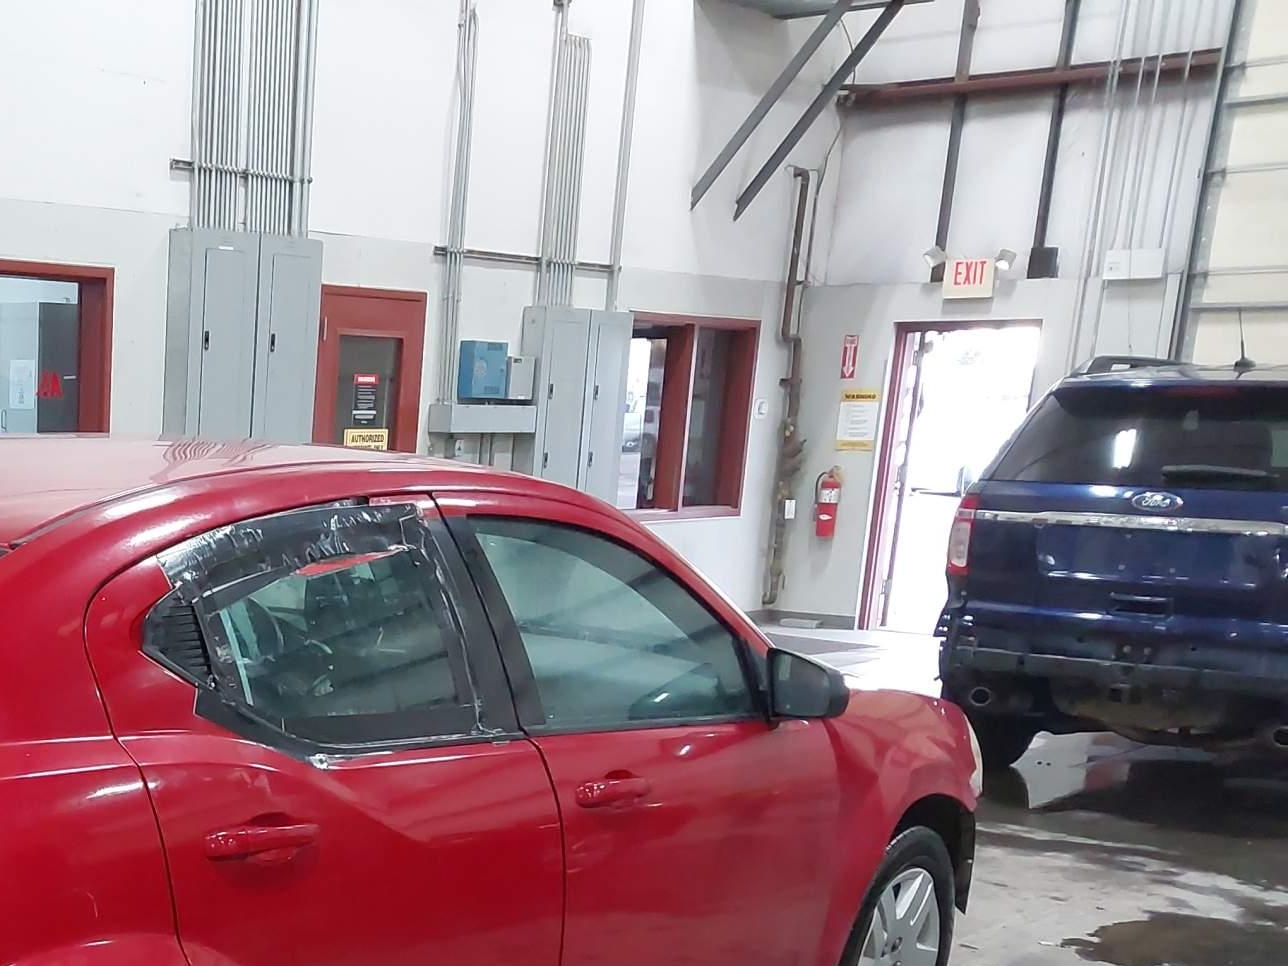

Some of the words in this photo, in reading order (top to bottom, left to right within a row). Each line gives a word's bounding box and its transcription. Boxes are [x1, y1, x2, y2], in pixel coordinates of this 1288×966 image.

[953, 260, 987, 286] EXIT
[351, 434, 385, 443] AUTHORIZED
[1141, 492, 1171, 508] Ford
